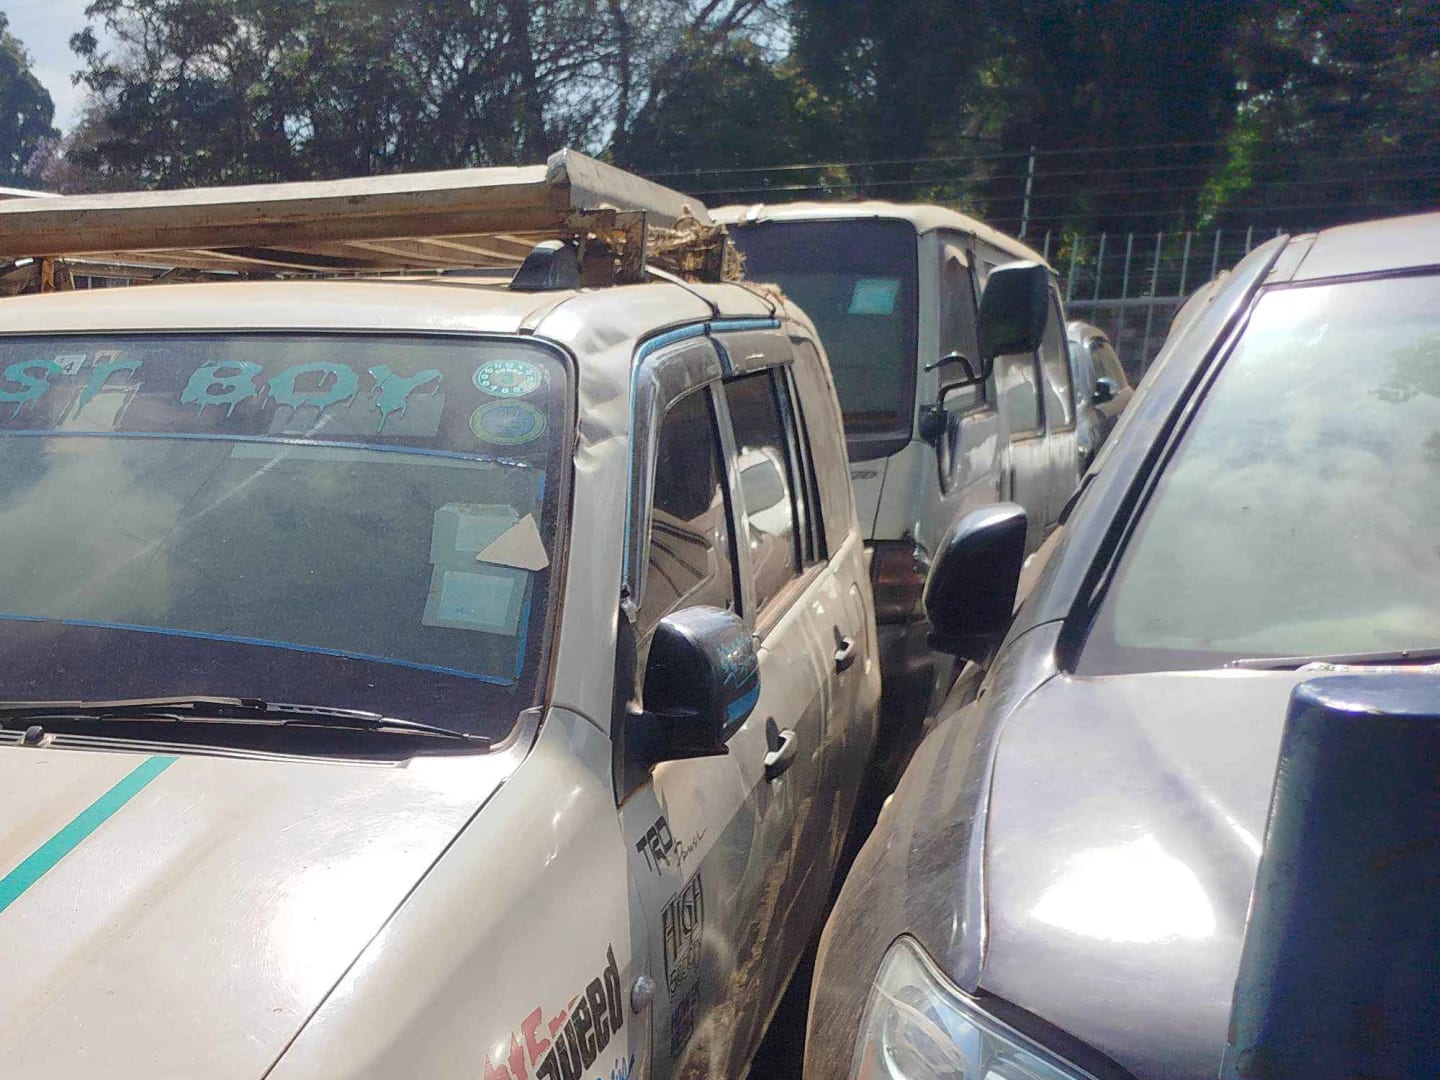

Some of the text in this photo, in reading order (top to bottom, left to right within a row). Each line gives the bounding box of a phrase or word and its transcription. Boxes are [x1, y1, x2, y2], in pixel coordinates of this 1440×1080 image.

[180, 359, 444, 433] BOY
[635, 815, 673, 877] TRD
[660, 867, 705, 964] HIGH
